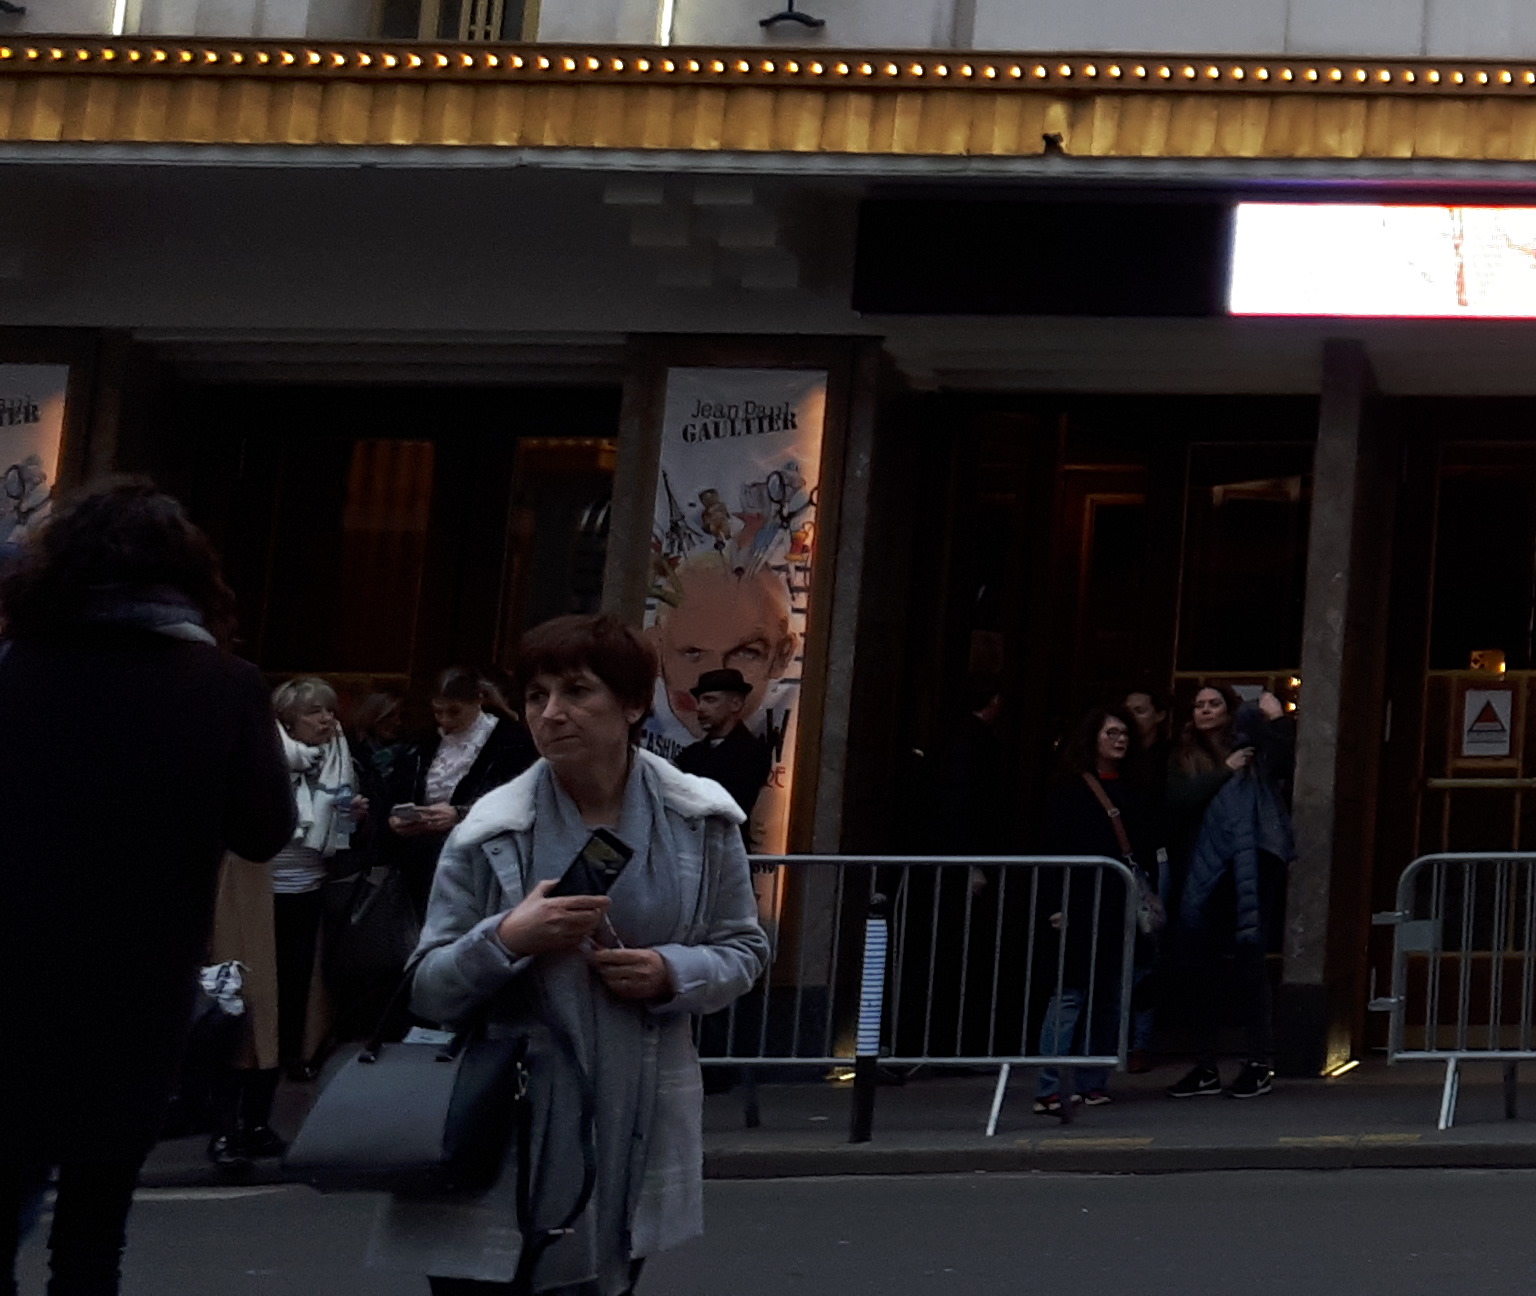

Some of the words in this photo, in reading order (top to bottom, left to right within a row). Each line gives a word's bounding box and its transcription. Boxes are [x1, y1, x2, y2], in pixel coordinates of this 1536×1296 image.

[691, 399, 739, 420] Jean
[744, 400, 791, 420] Paul
[682, 412, 797, 443] GAULTIER
